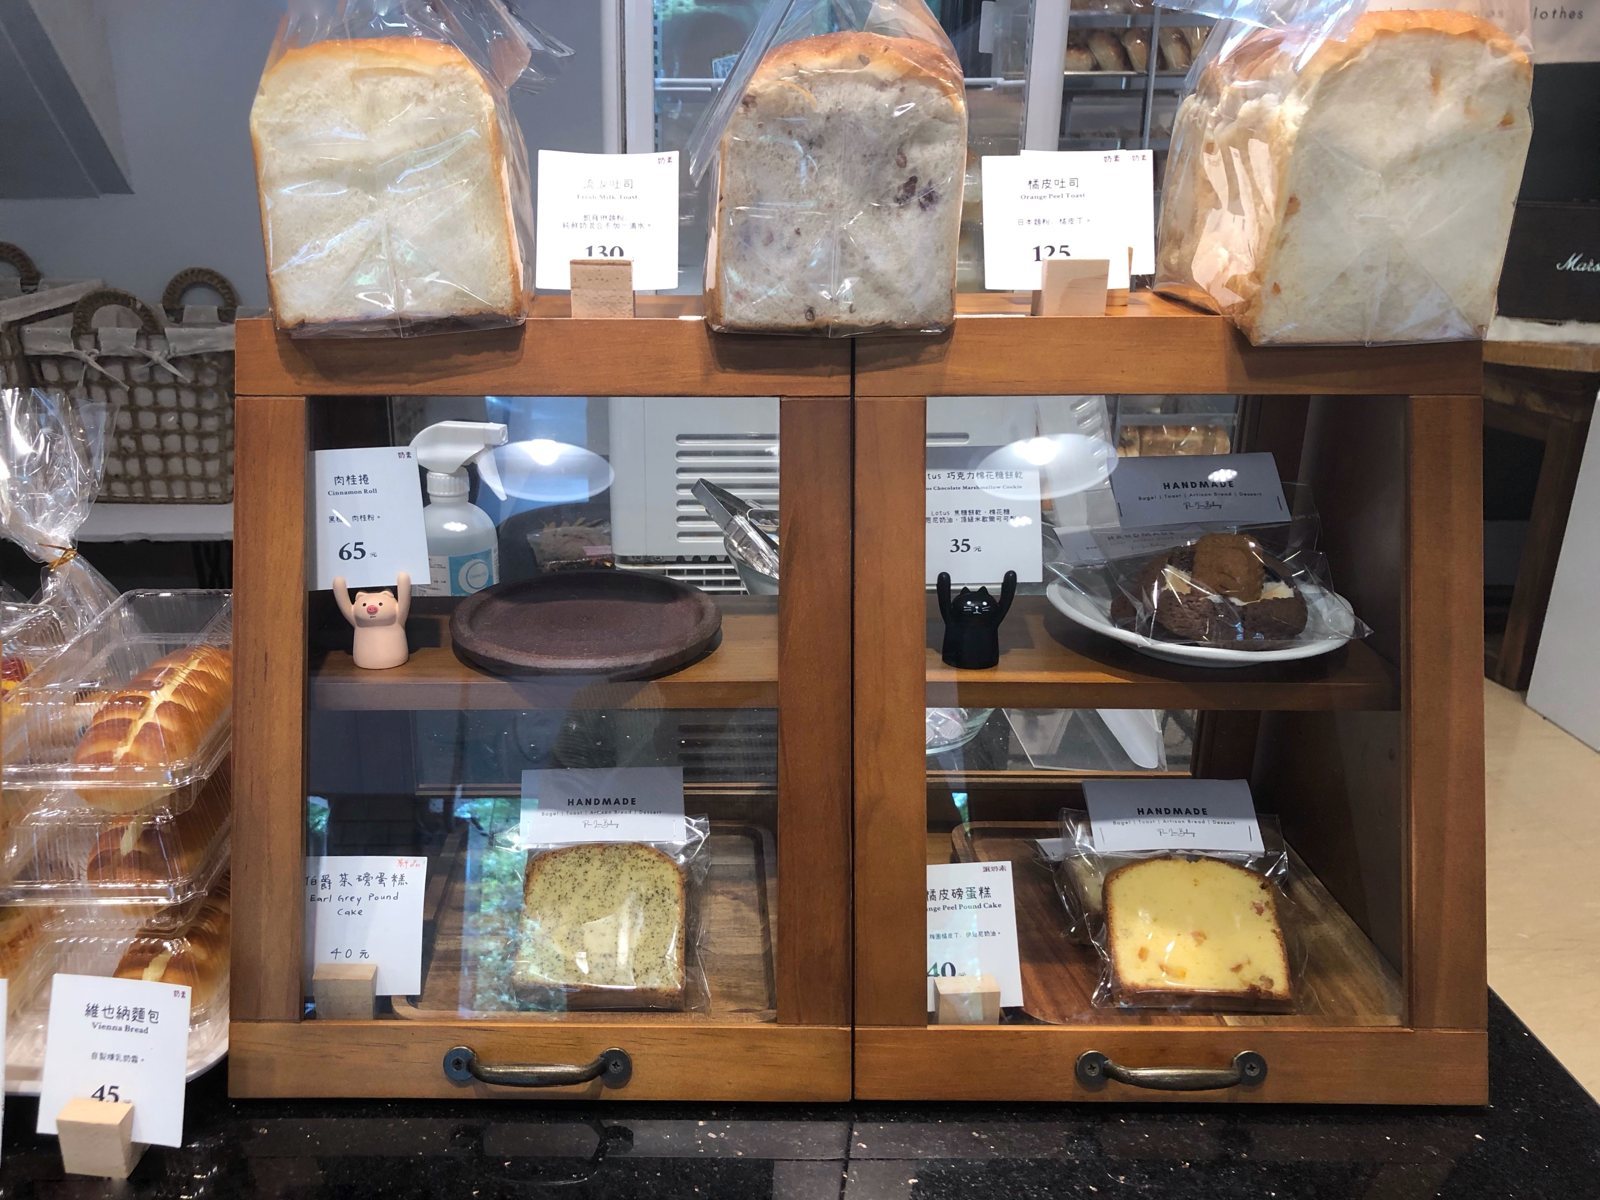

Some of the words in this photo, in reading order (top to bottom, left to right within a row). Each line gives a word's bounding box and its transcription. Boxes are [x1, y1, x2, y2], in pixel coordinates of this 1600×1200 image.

[1532, 7, 1584, 20] lothes
[1103, 155, 1120, 163] 奶素
[1028, 177, 1079, 190] 橘皮吐司
[585, 245, 625, 257] 130
[1032, 245, 1071, 261] 125
[397, 451, 412, 459] 奶素
[334, 474, 370, 486] 肉桂捲
[947, 471, 1023, 480] 巧克力棉花糖餅乾
[1163, 480, 1235, 490] HANDMADE
[339, 542, 366, 560] 65
[950, 538, 971, 553] 35
[567, 797, 637, 806] HANDMADE
[1137, 807, 1209, 816] HANDMADE
[305, 872, 409, 890] 伯爵茶磅蛋糕
[310, 894, 332, 902] Earl
[337, 894, 362, 906] Grey
[368, 891, 399, 901] Pound
[337, 908, 364, 916] Cake
[330, 948, 353, 959] 40
[359, 949, 370, 959] 元
[927, 961, 956, 977] 40
[173, 990, 186, 998] 奶素
[84, 1002, 160, 1024] 維也納麵包
[91, 1022, 123, 1032] Vienna
[124, 1024, 149, 1034] Bread
[91, 1084, 120, 1103] 45
